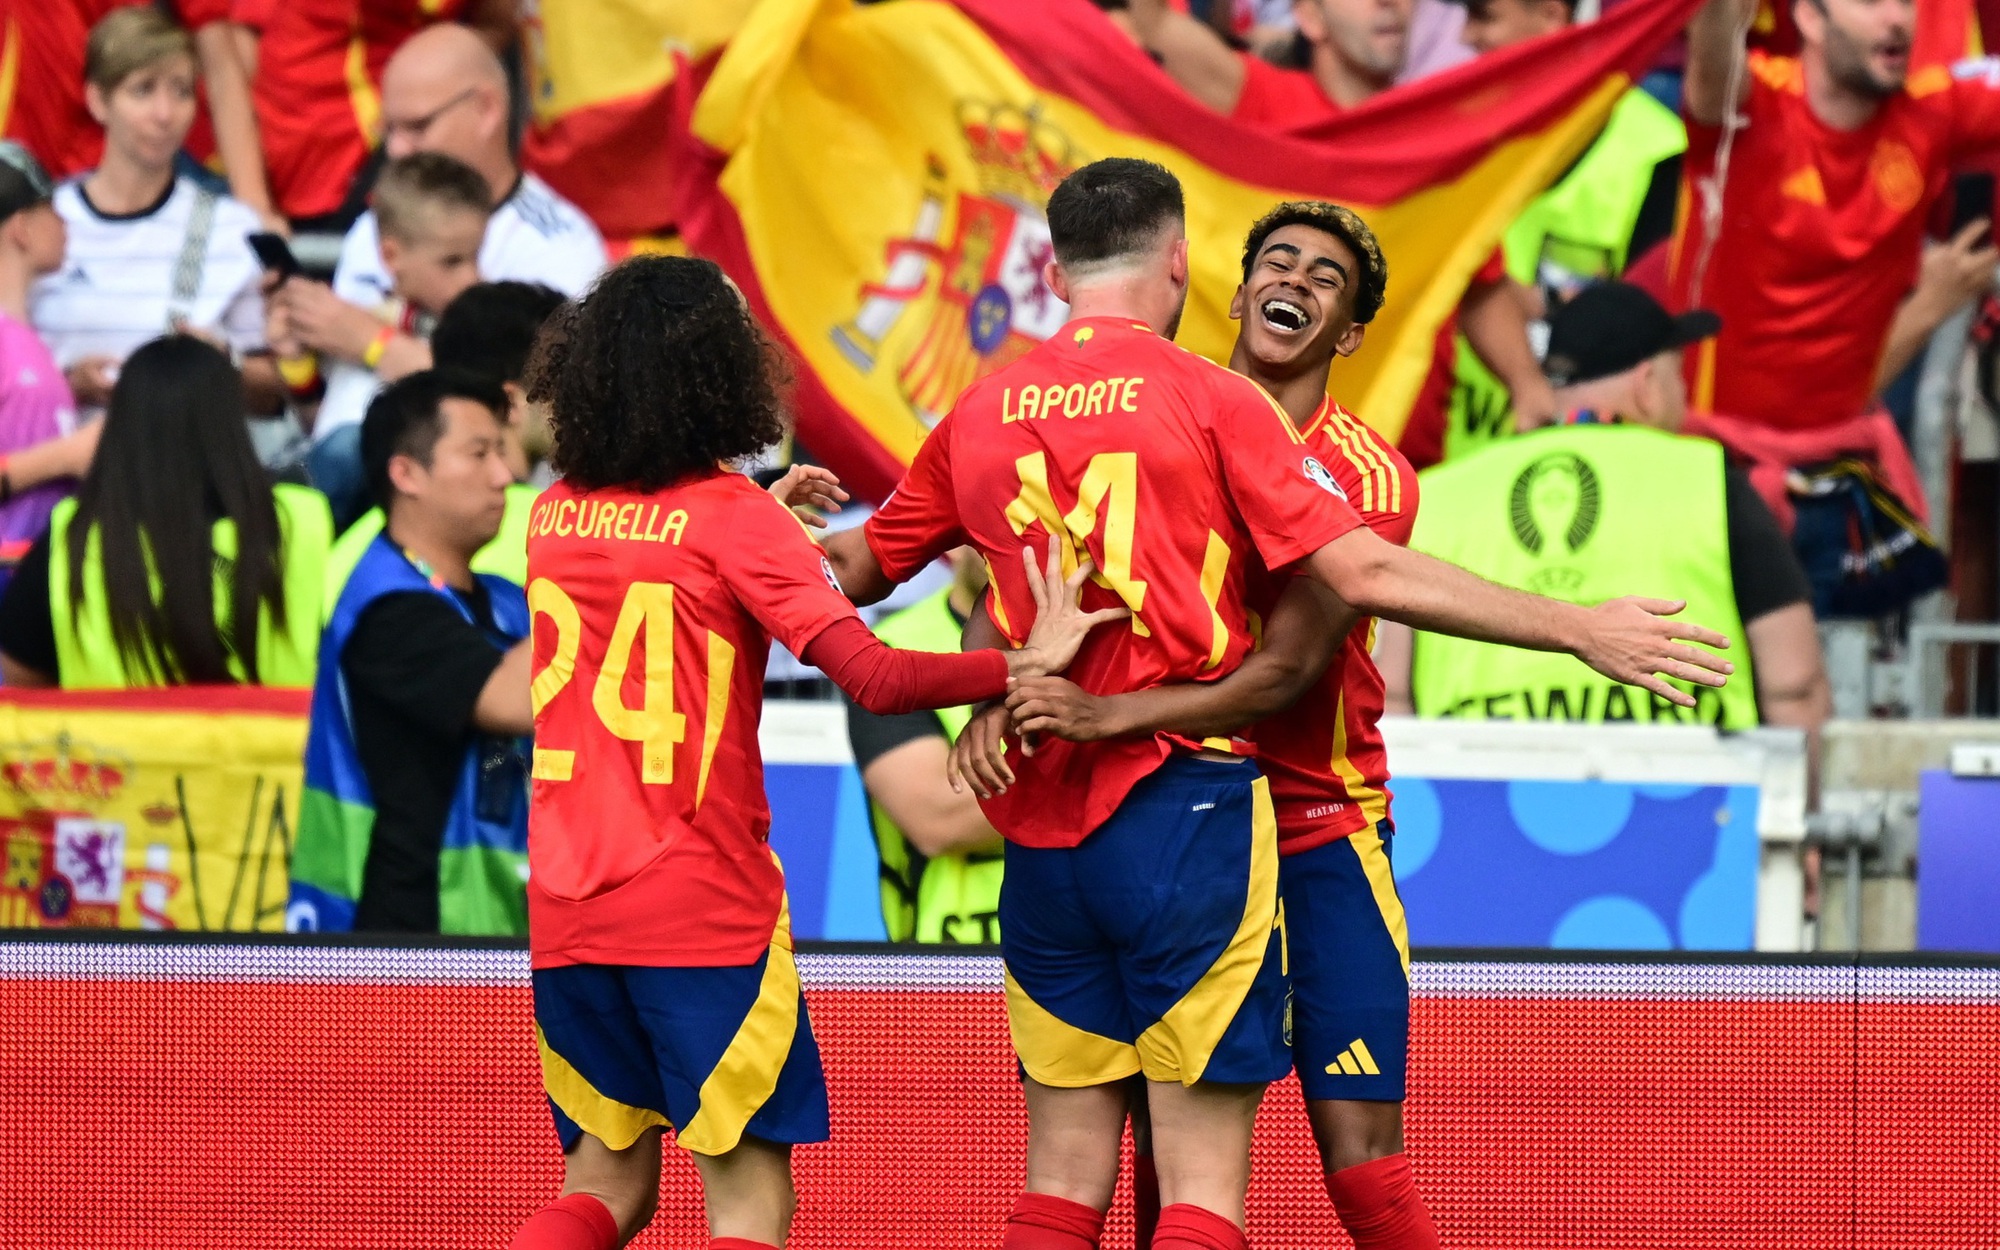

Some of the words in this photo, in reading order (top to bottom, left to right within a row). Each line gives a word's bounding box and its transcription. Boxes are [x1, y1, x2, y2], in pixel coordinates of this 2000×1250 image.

[1002, 377, 1144, 425] LAPORTE
[530, 499, 689, 546] CUCURELLA
[1004, 450, 1151, 638] 14
[527, 577, 687, 785] 24
[1438, 684, 1729, 724] EWARD
[1306, 803, 1345, 819] HEAT.RDY
